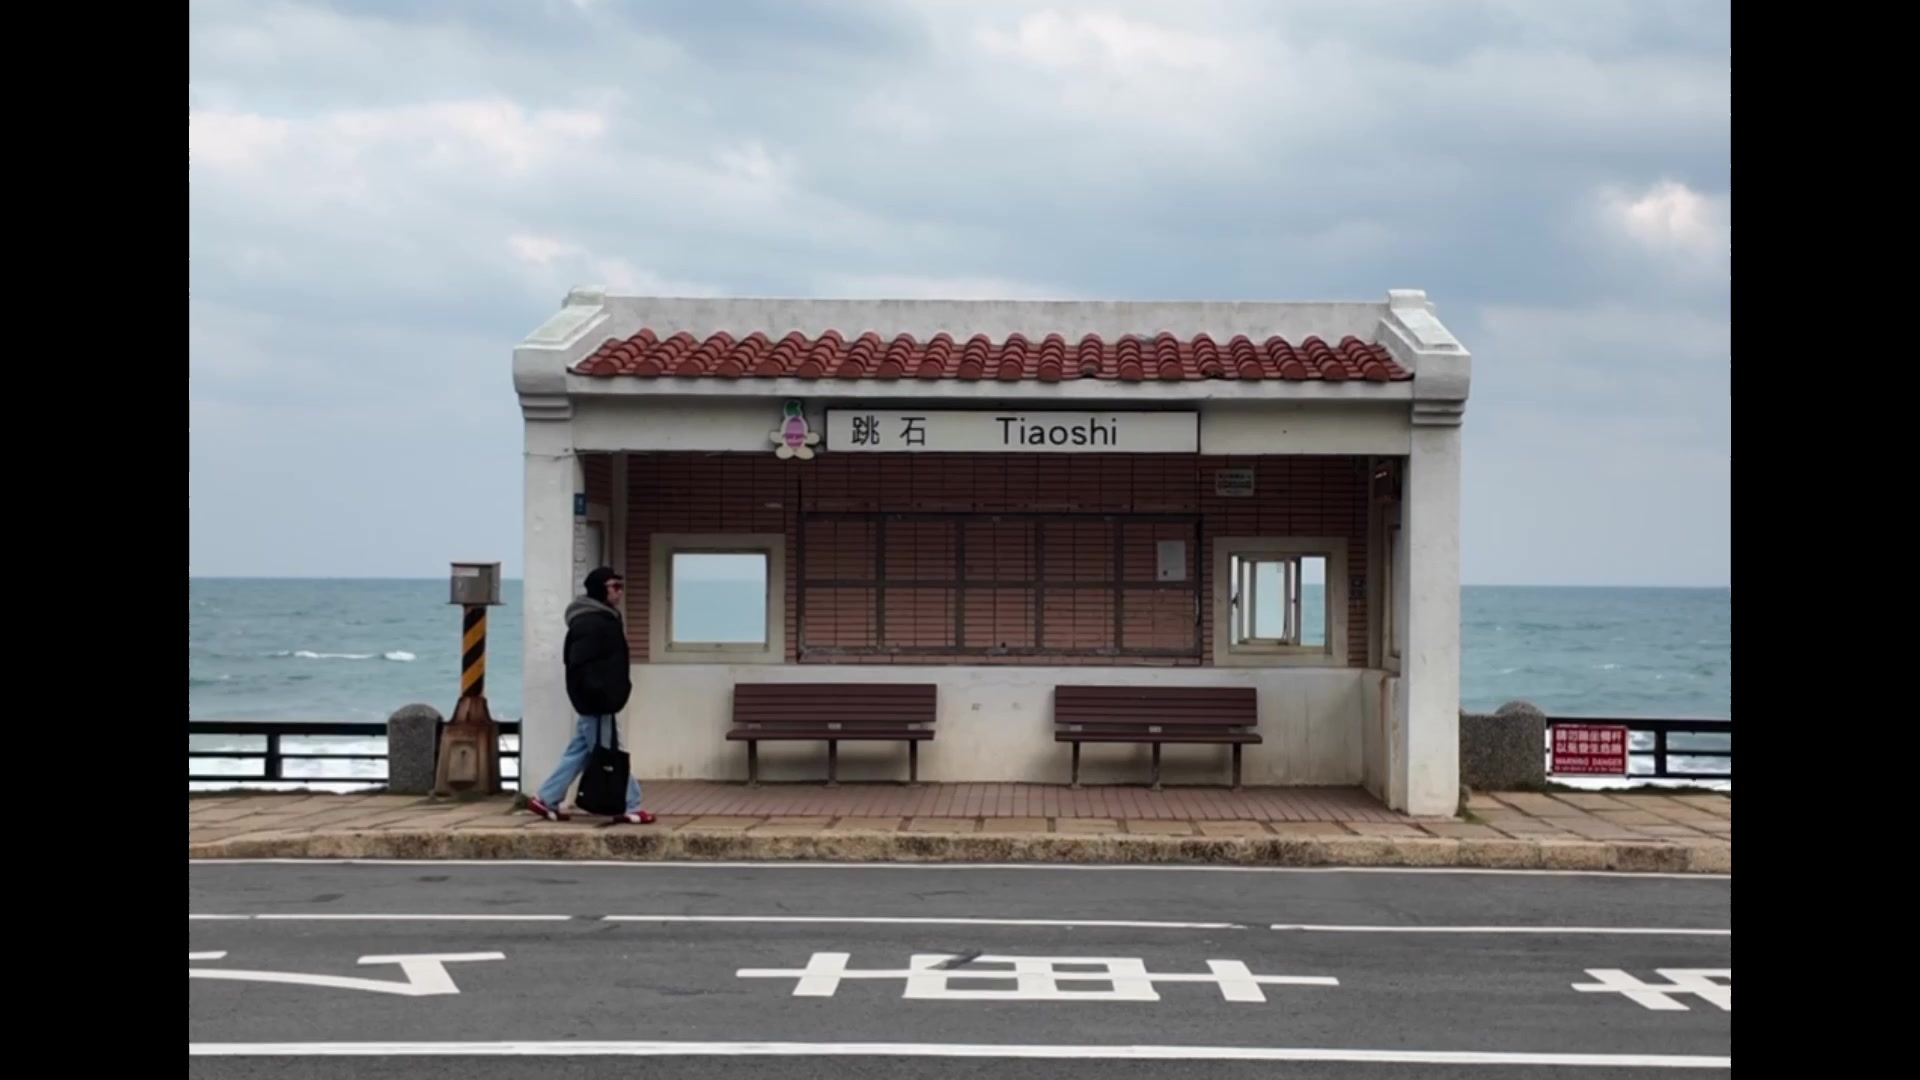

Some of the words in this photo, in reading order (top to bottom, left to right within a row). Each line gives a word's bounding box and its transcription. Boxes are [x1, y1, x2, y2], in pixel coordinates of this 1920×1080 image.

[852, 415, 927, 446] 跳石
[995, 416, 1118, 446] Tiaoshi
[1592, 757, 1622, 766] DANGER
